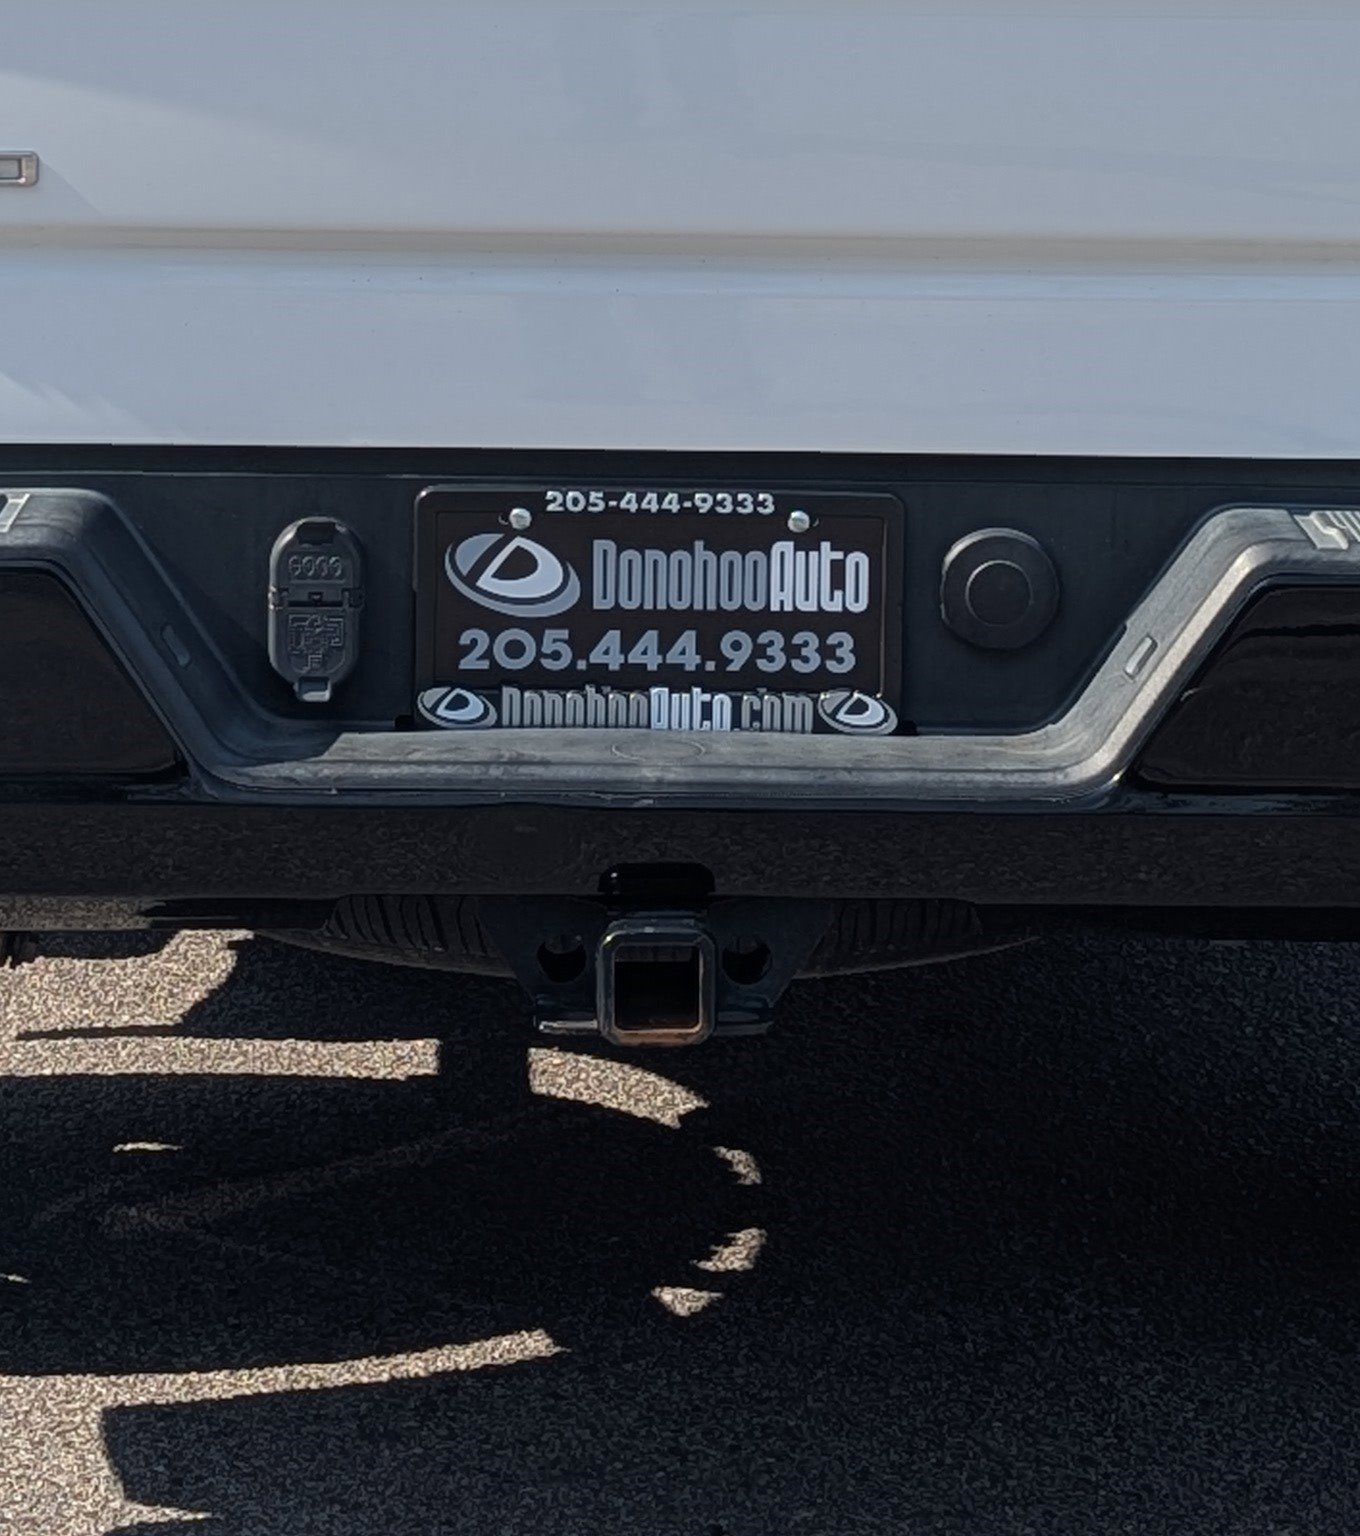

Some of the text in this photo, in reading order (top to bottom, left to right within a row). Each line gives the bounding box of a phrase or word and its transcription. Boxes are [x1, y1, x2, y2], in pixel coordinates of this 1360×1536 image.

[545, 490, 775, 514] 205-444-9333
[593, 539, 869, 613] DonohooAuto
[459, 628, 856, 673] 205.444.9333
